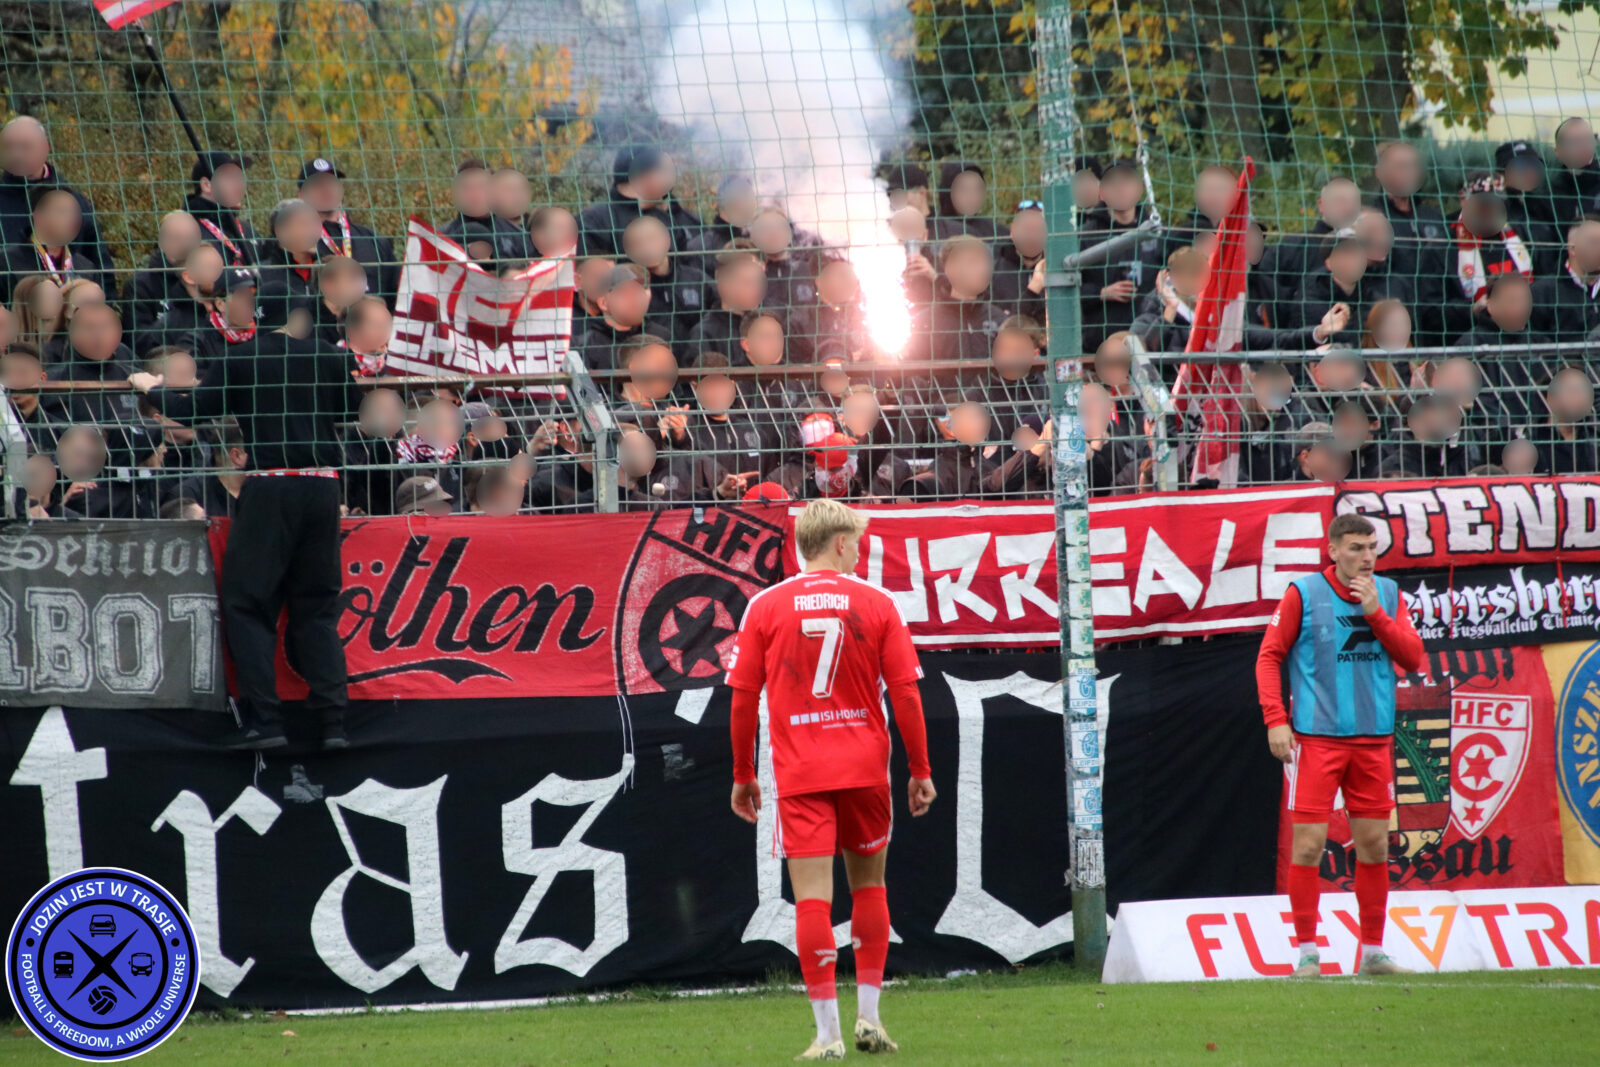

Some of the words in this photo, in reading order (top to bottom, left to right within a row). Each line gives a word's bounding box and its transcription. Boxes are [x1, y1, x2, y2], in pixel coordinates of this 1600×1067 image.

[387, 318, 568, 375] CHEMIE
[682, 506, 782, 583] HFC
[796, 512, 1326, 624] URREALE
[335, 534, 607, 655] öthen
[794, 593, 849, 611] FRIEDRICH
[801, 617, 844, 699] 7
[1337, 652, 1381, 664] PATRICK
[835, 708, 867, 720] HOME
[1453, 699, 1514, 727] HFC
